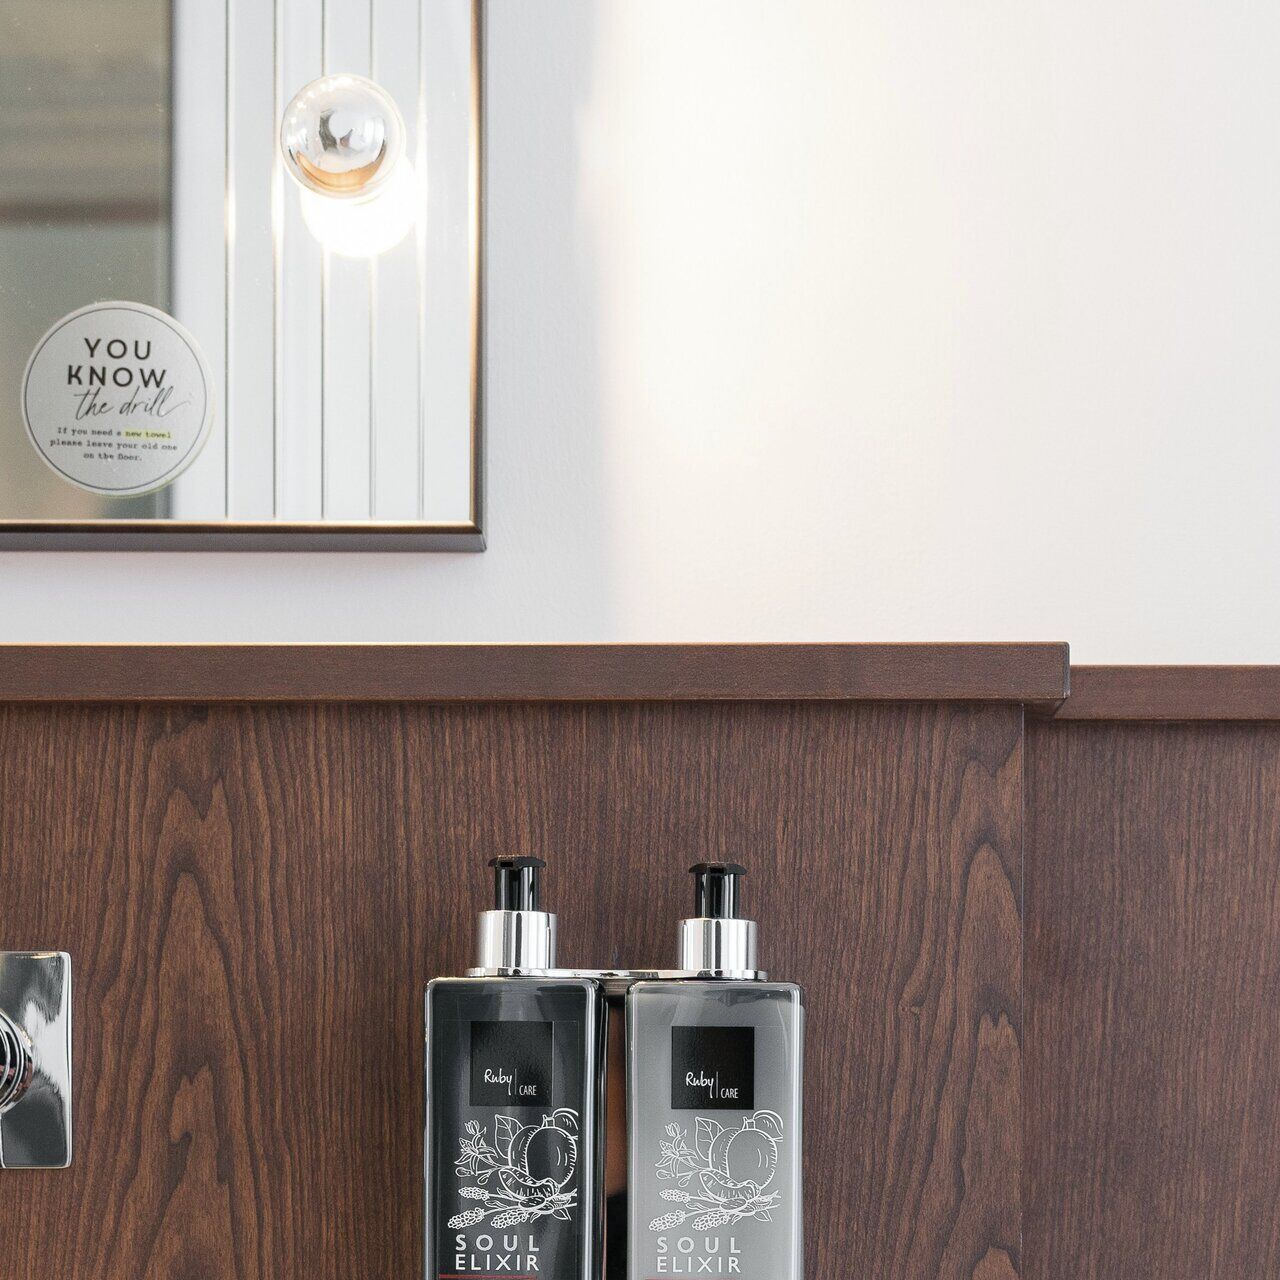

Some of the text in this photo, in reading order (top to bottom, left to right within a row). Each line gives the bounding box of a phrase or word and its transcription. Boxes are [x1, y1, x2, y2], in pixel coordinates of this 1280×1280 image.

[84, 337, 151, 360] YOU
[67, 365, 167, 388] KNOW
[74, 386, 191, 421] the drill
[145, 430, 171, 439] towel
[49, 439, 83, 447] please
[87, 440, 113, 448] leave
[117, 442, 137, 450] your
[98, 452, 114, 460] the
[484, 1067, 537, 1096] Ruby CARE
[685, 1071, 739, 1099] Ruby CARE
[455, 1234, 540, 1252] SOUL
[656, 1236, 741, 1254] SOUL
[455, 1254, 540, 1271] ELIXIR
[656, 1256, 741, 1273] ELIXIR
